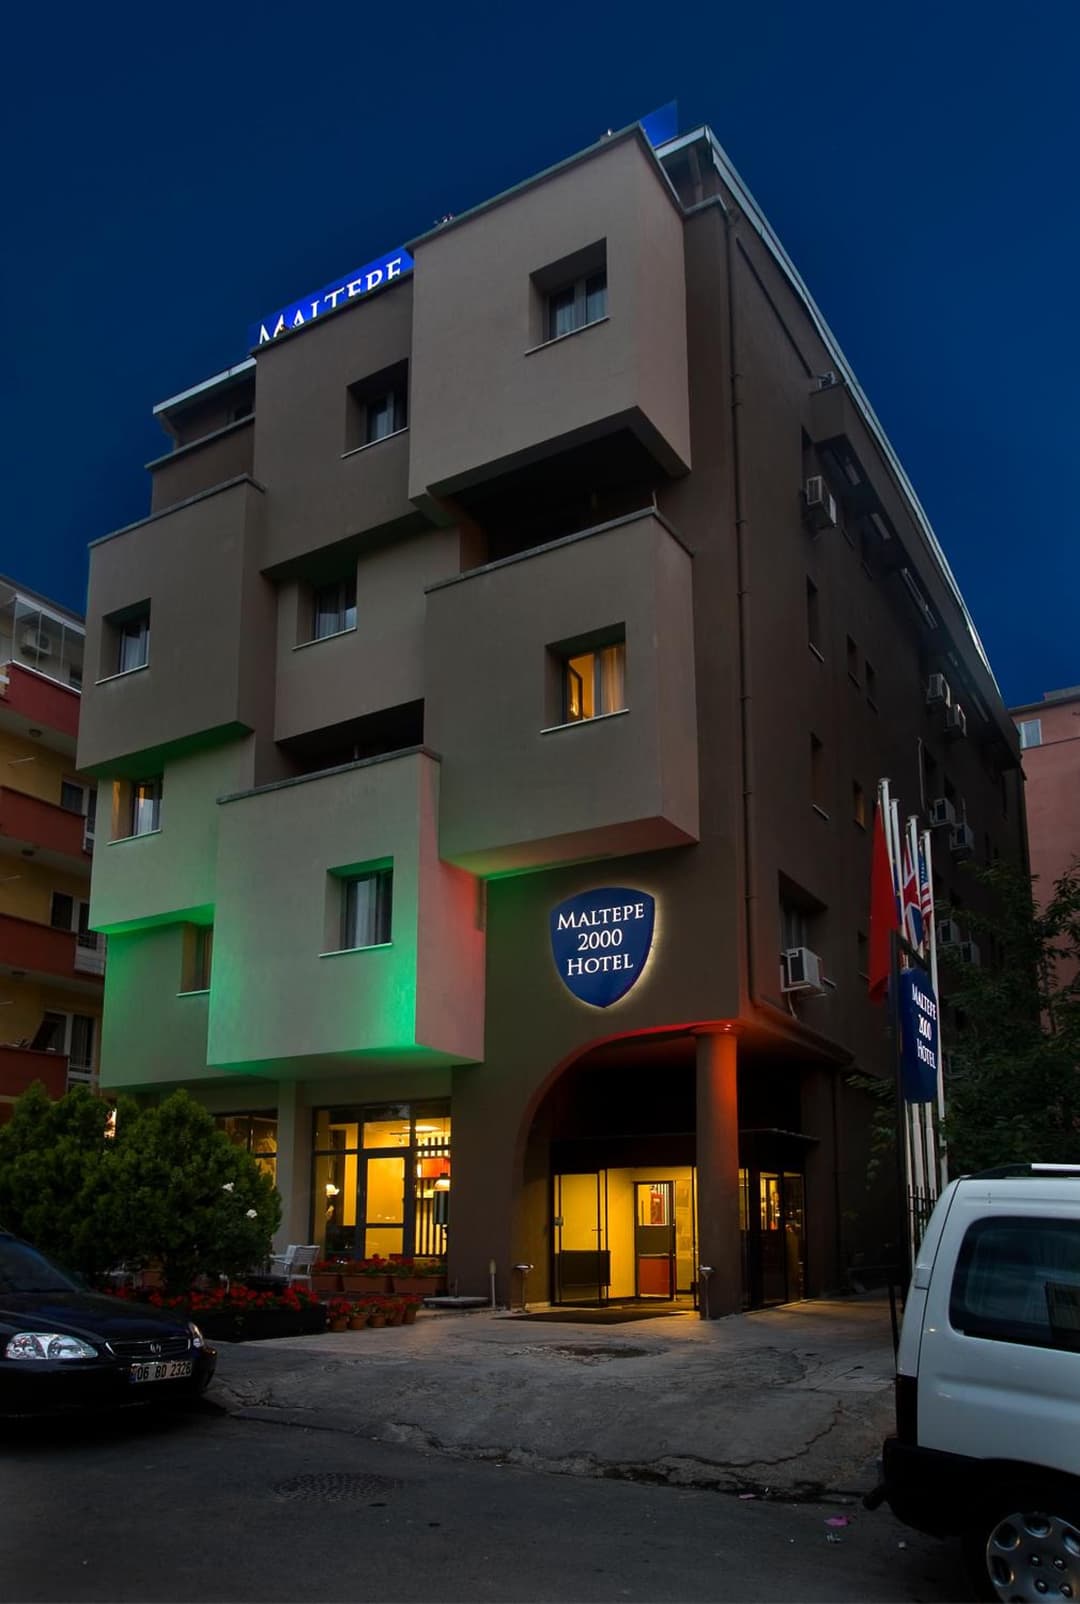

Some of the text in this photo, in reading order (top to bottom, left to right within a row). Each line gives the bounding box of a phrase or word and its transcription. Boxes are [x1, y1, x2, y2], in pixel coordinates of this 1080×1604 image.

[557, 903, 645, 931] MALTEPE
[577, 928, 623, 951] 2000
[567, 953, 634, 976] HOTEL
[912, 983, 936, 1020] MALTEPE
[916, 1038, 936, 1069] HOTEL
[137, 1366, 149, 1380] 06
